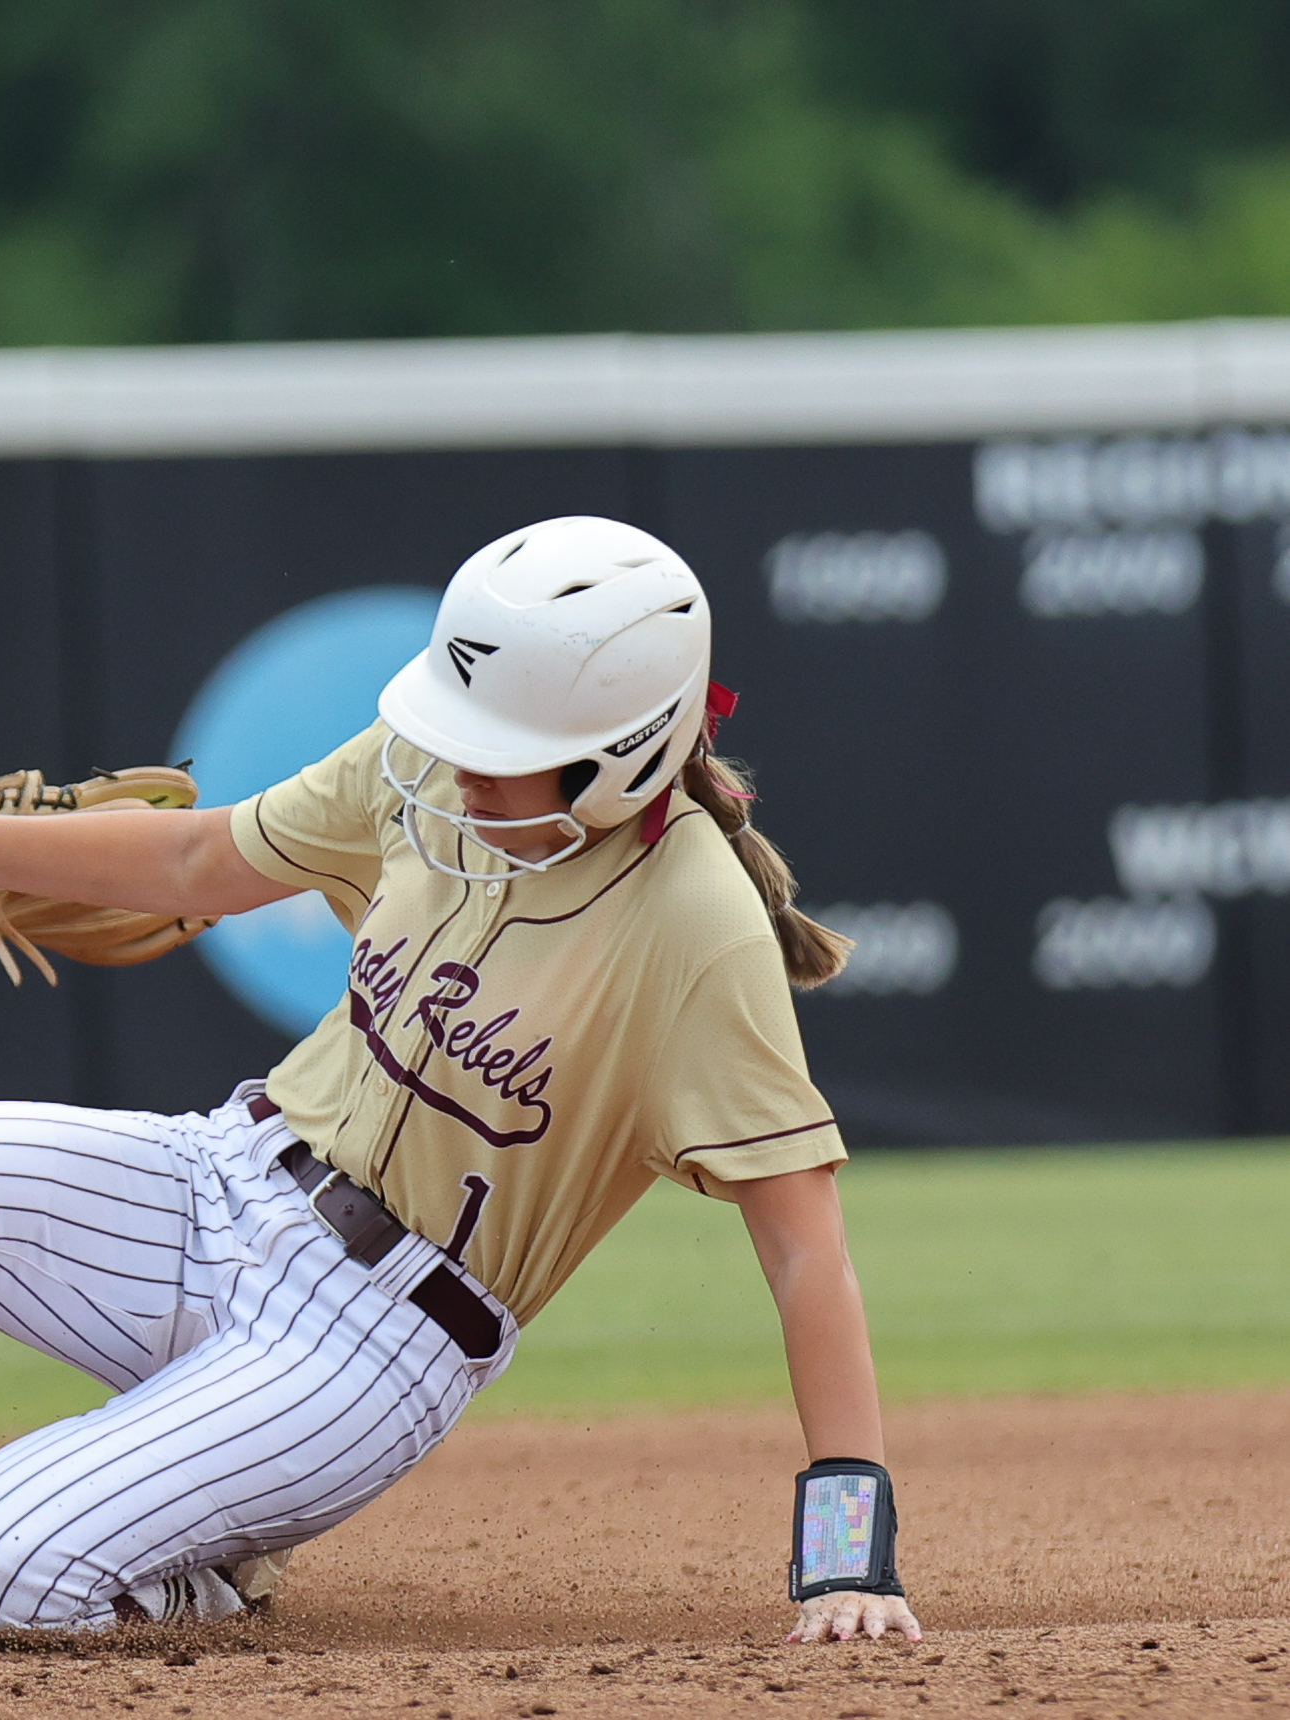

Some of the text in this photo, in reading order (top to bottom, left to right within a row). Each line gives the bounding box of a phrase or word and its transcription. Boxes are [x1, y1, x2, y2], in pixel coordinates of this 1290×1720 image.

[616, 712, 669, 753] EASTON
[349, 895, 553, 1100] ady Rebels
[447, 1171, 494, 1266] 1
